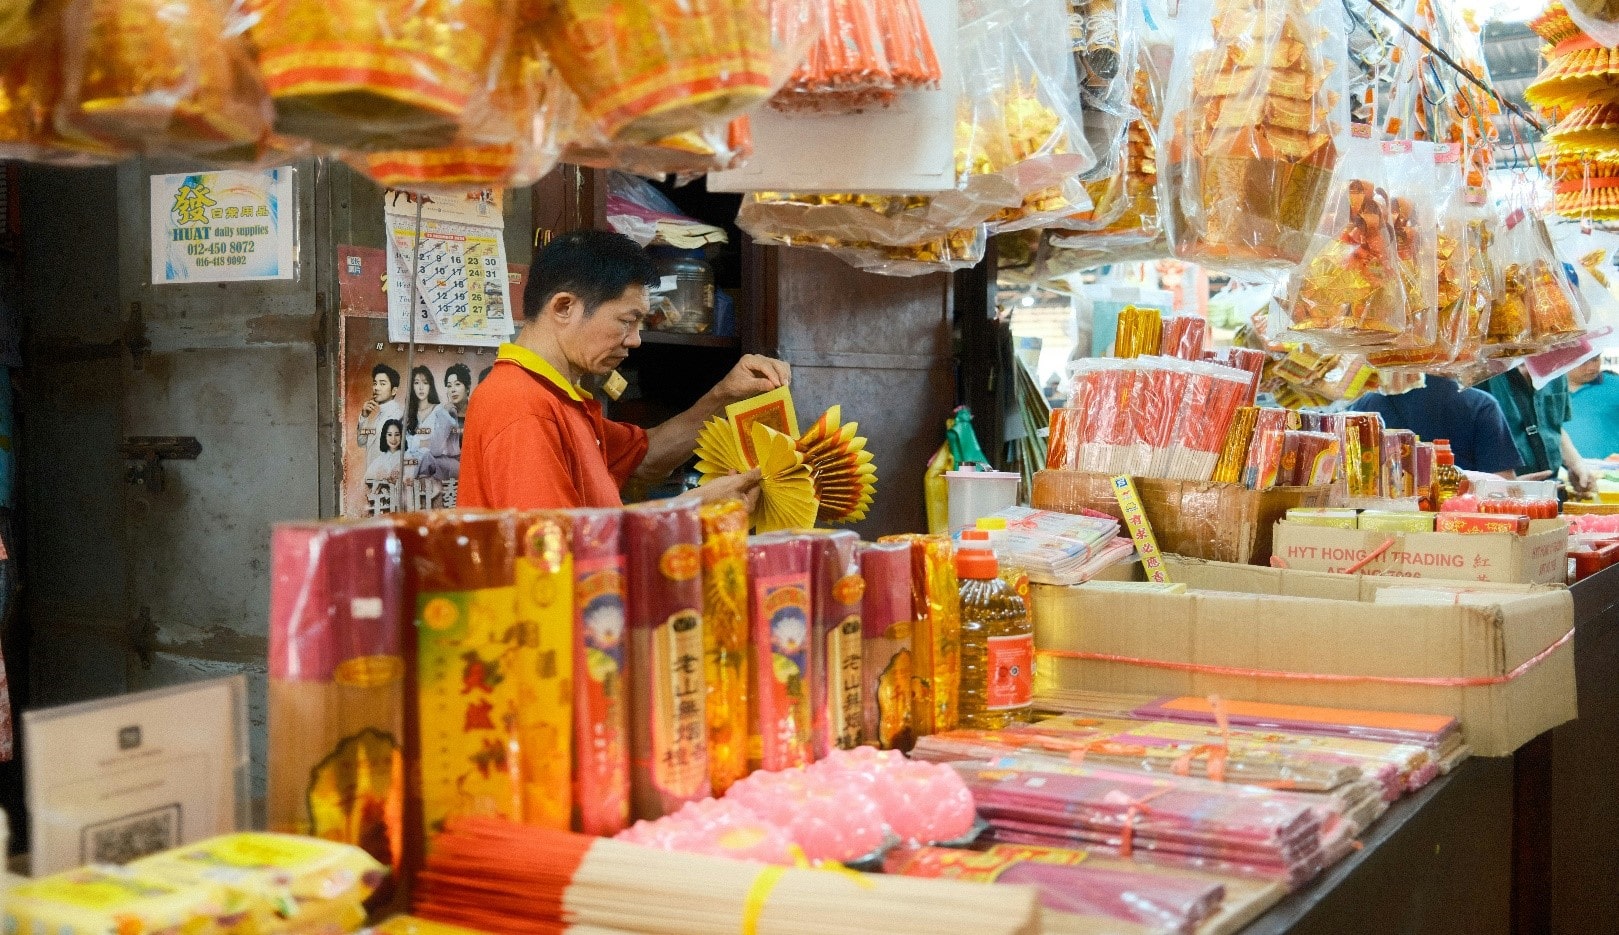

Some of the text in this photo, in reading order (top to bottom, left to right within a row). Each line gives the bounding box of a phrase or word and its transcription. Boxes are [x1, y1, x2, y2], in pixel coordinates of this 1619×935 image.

[171, 184, 217, 225] 發
[211, 206, 269, 219] 日常用品
[172, 225, 269, 242] HUAT daily supplies
[187, 241, 255, 255] 012-450 8072
[196, 257, 225, 267] 016-418
[451, 256, 461, 264] 16
[468, 257, 479, 265] 23
[485, 258, 496, 266] 30
[421, 310, 429, 319] 3
[456, 305, 466, 313] 20
[423, 323, 430, 332] 4
[1288, 545, 1317, 559] HYT
[1321, 547, 1368, 562] HONG
[1391, 551, 1465, 568] TRADING
